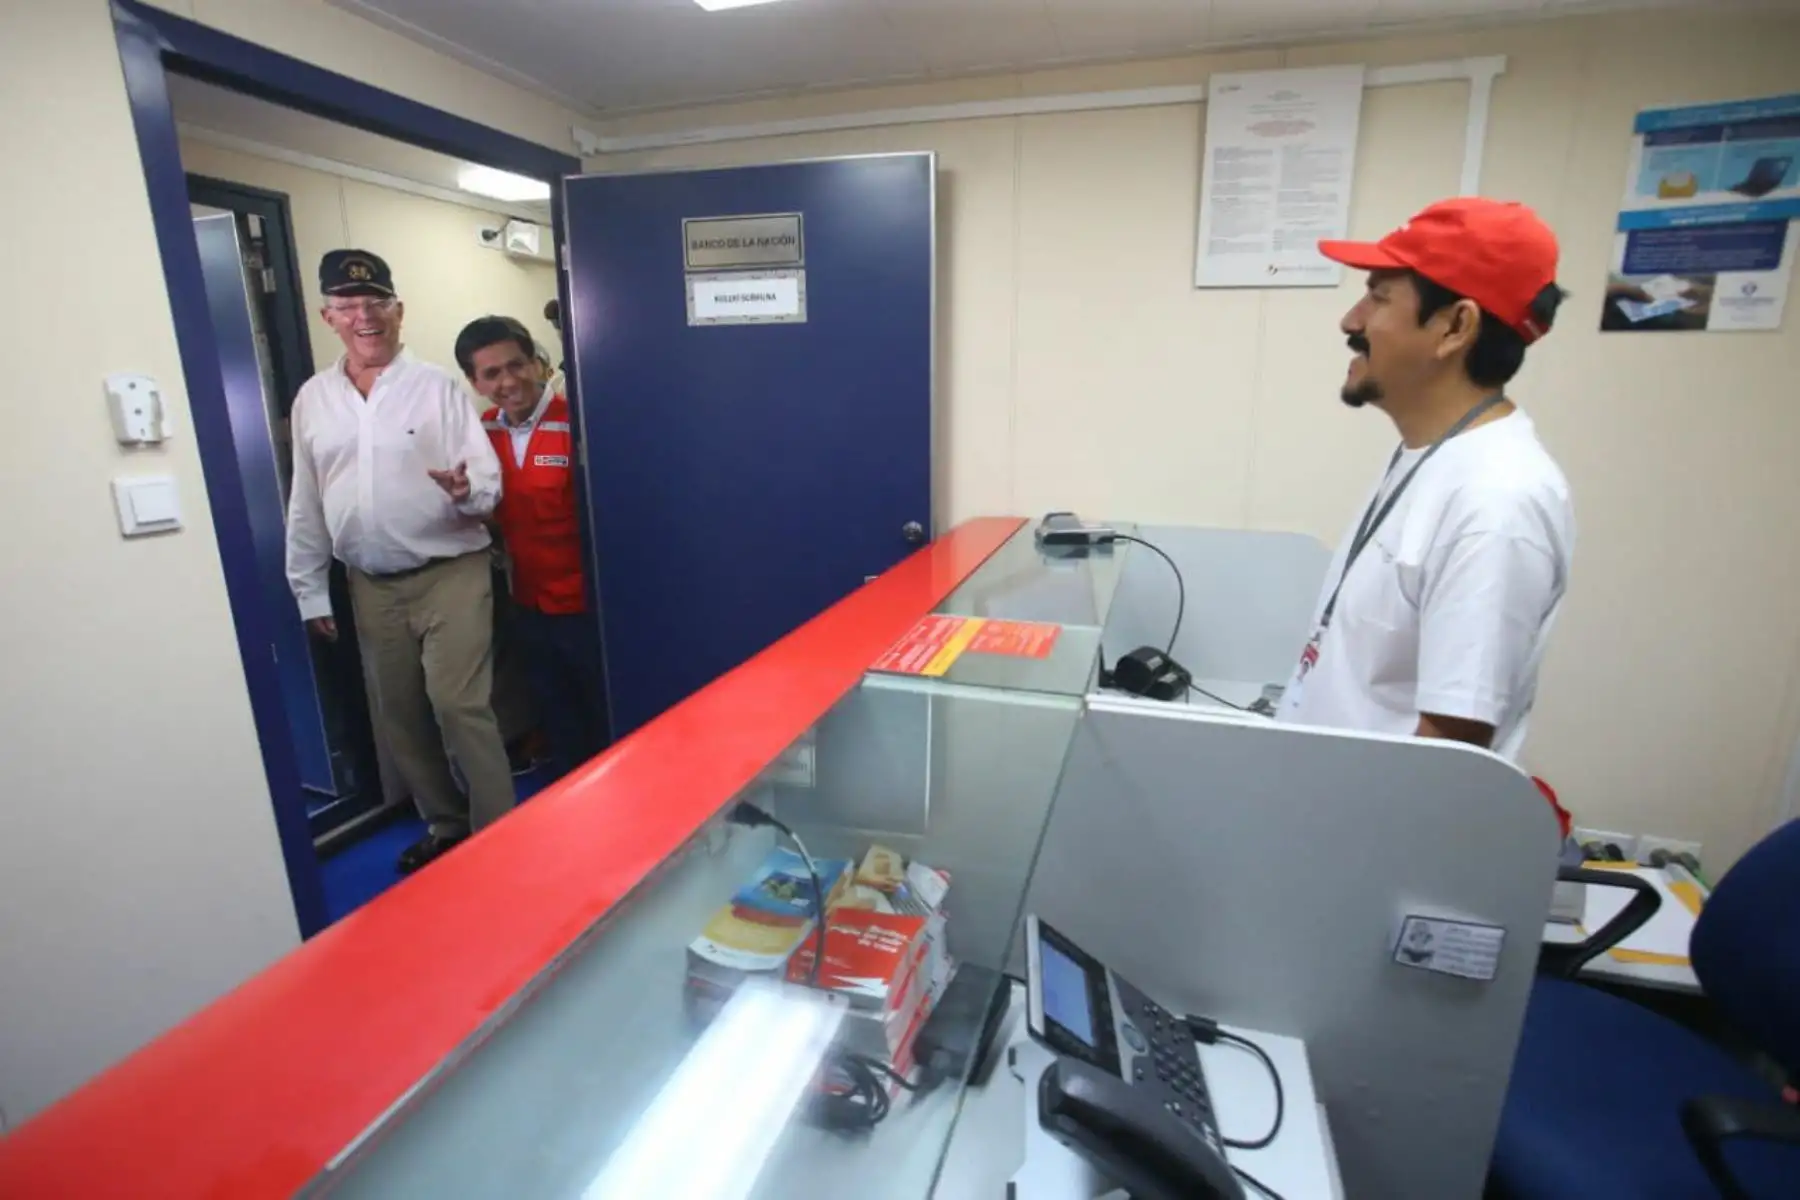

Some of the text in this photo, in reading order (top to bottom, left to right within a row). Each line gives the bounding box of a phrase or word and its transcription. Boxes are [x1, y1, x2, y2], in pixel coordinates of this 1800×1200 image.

[691, 233, 795, 250] BANCO DE LA NACIÓN
